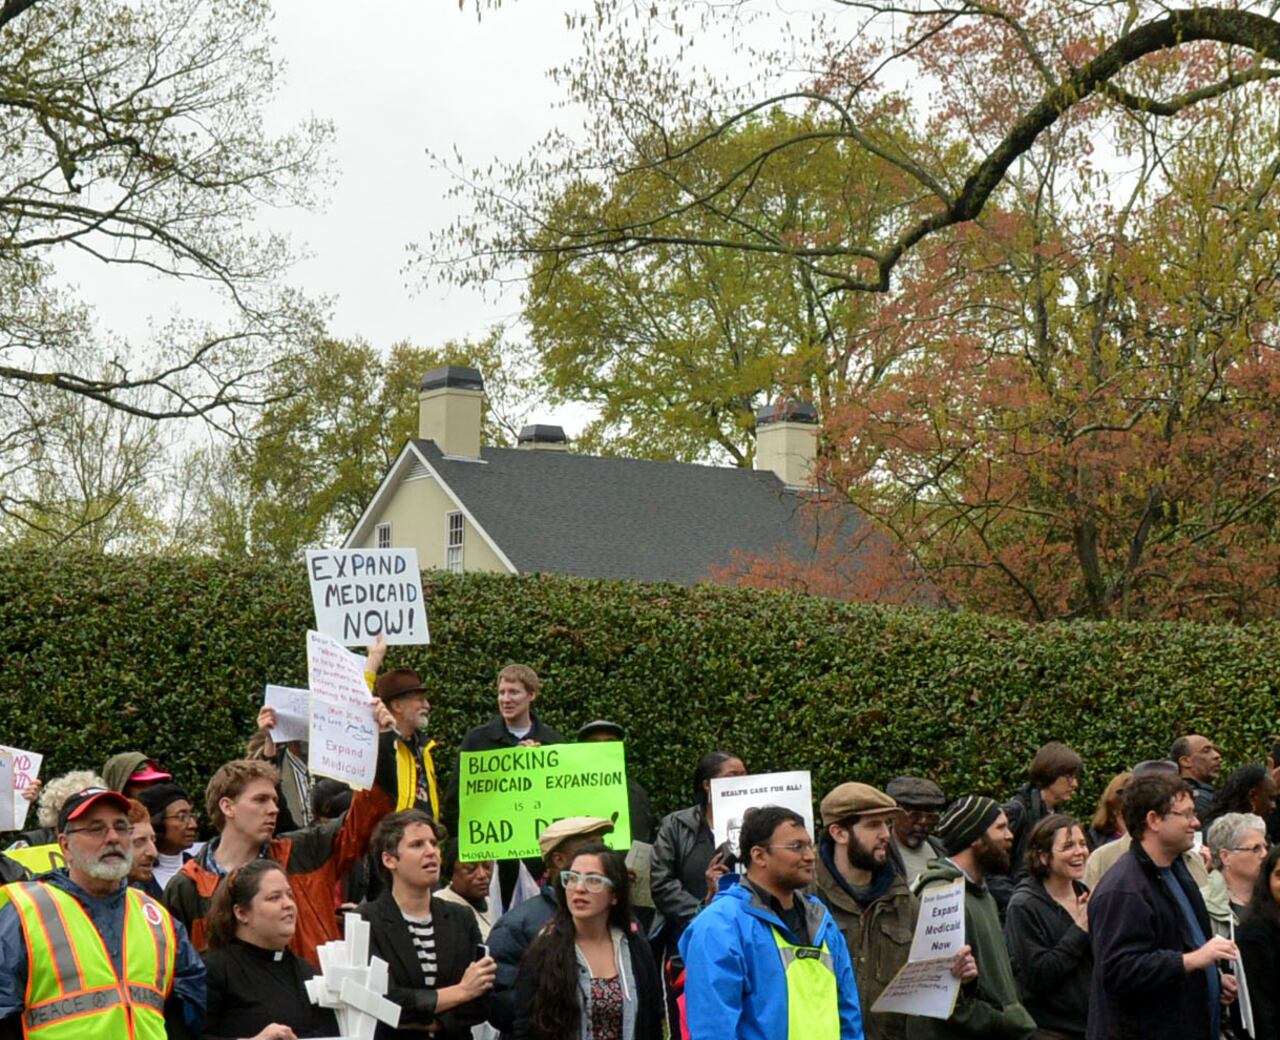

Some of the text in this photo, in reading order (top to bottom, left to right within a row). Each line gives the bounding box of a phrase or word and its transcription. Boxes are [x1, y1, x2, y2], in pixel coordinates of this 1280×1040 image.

[311, 553, 406, 581] EXPAND
[325, 583, 417, 608] MEDICAID
[343, 607, 414, 640] NOW!
[469, 750, 559, 775] BLOCKING
[466, 771, 622, 796] MEDICAID EXPANSION
[470, 819, 513, 845] BAD
[461, 850, 499, 861] MORAL
